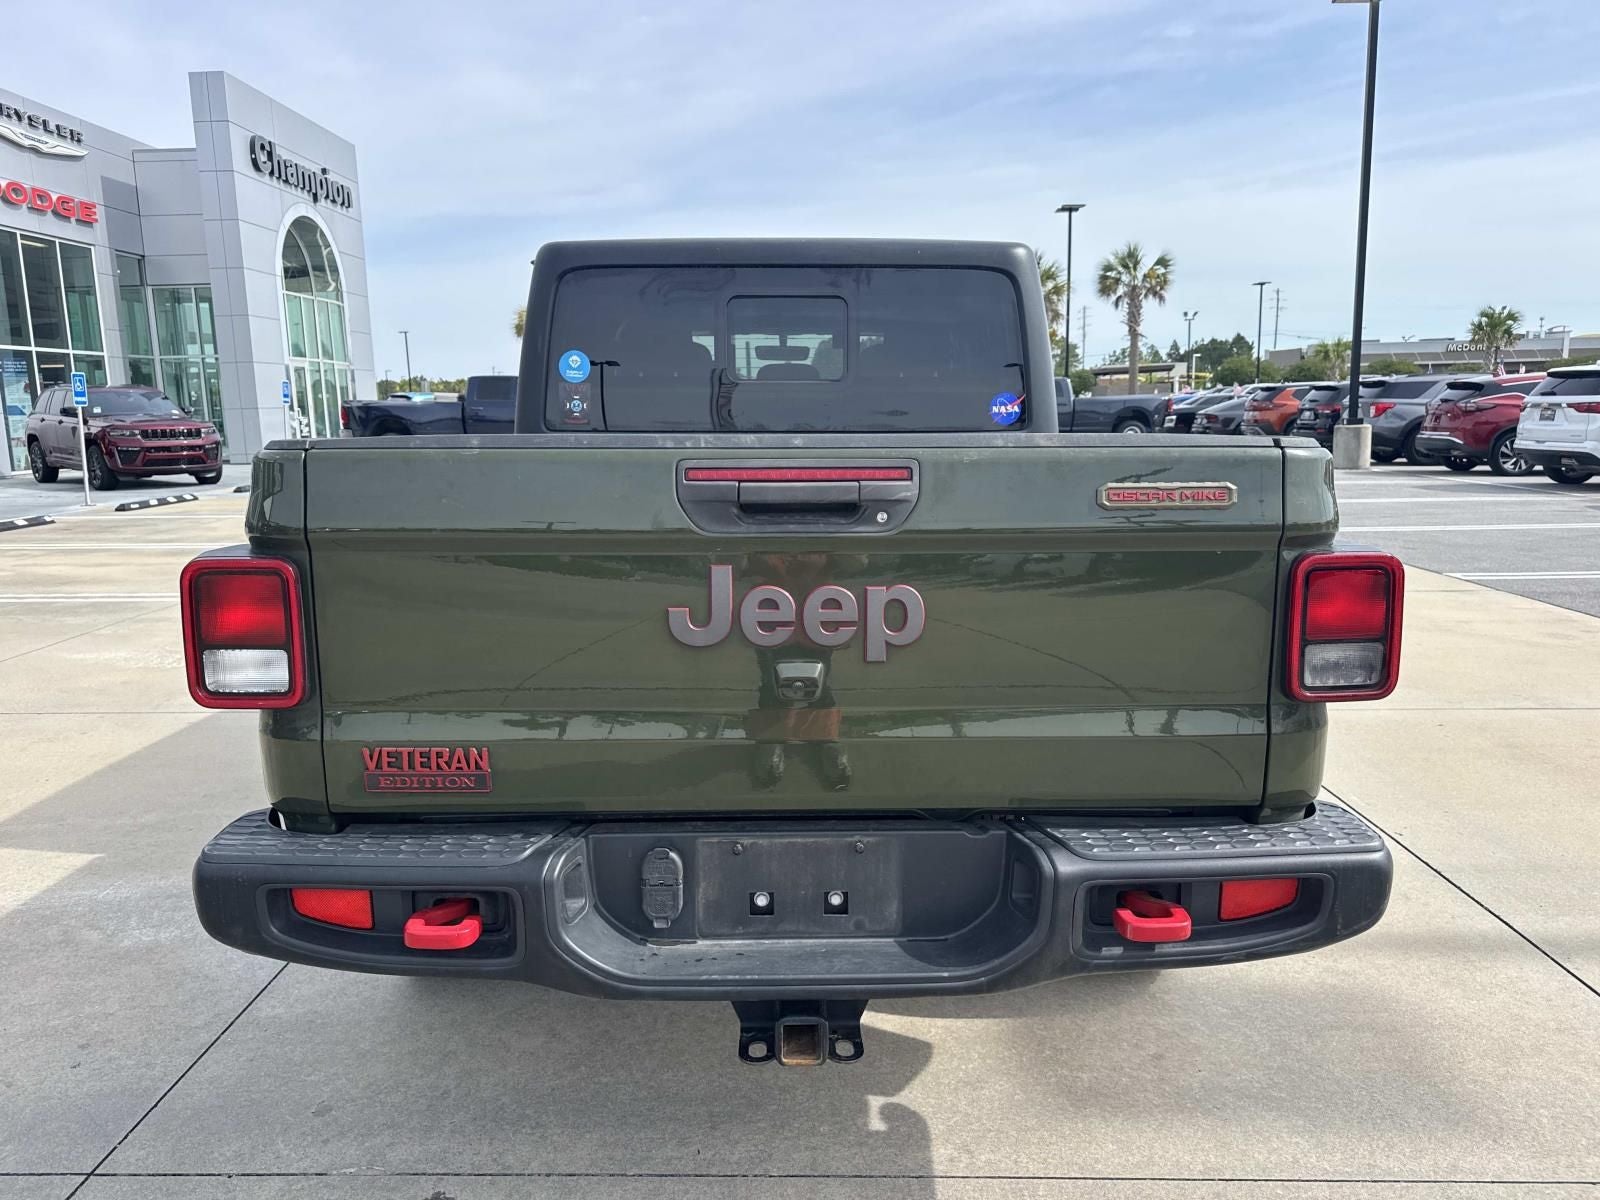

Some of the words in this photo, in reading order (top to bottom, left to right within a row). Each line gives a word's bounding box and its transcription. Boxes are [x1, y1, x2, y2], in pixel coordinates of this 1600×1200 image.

[249, 135, 353, 208] Champion
[0, 182, 98, 223] ODGE
[992, 405, 1020, 413] NASA
[1107, 491, 1177, 501] OSCAR
[1180, 491, 1228, 501] MIKE
[667, 564, 926, 662] Jeep
[361, 747, 490, 772] VETERAN
[377, 776, 477, 788] EDITION
